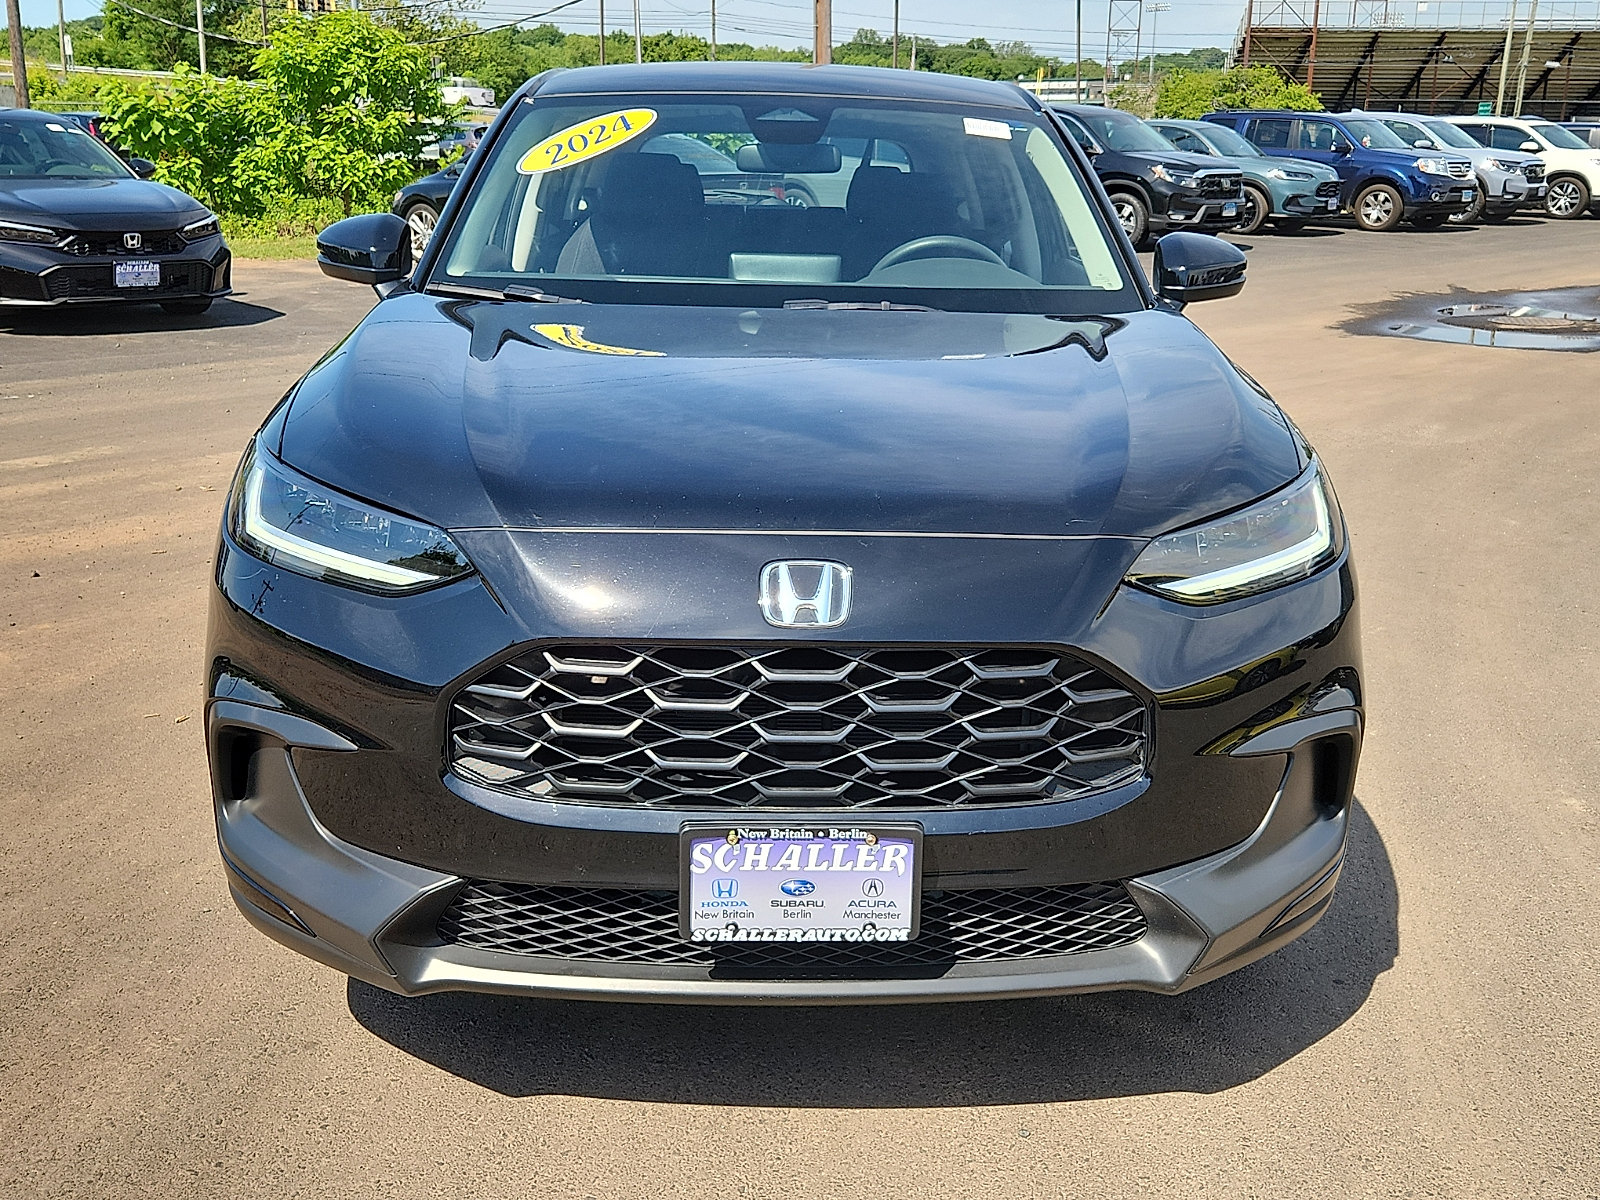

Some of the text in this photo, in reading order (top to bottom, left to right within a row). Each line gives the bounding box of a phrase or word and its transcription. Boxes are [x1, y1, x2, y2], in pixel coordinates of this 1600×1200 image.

[545, 115, 634, 165] 2024
[116, 263, 159, 273] SCHALLER
[737, 828, 868, 839] New Britain Berlin
[690, 843, 908, 876] SCHALLER
[701, 900, 748, 908] HONDA
[770, 899, 824, 908] SUBARU
[847, 900, 897, 908] ACURA
[694, 909, 755, 920] New Britain
[783, 909, 811, 919] Berlin
[842, 910, 902, 920] Manchester
[691, 928, 911, 942] SCHALLERAUTO.COM
